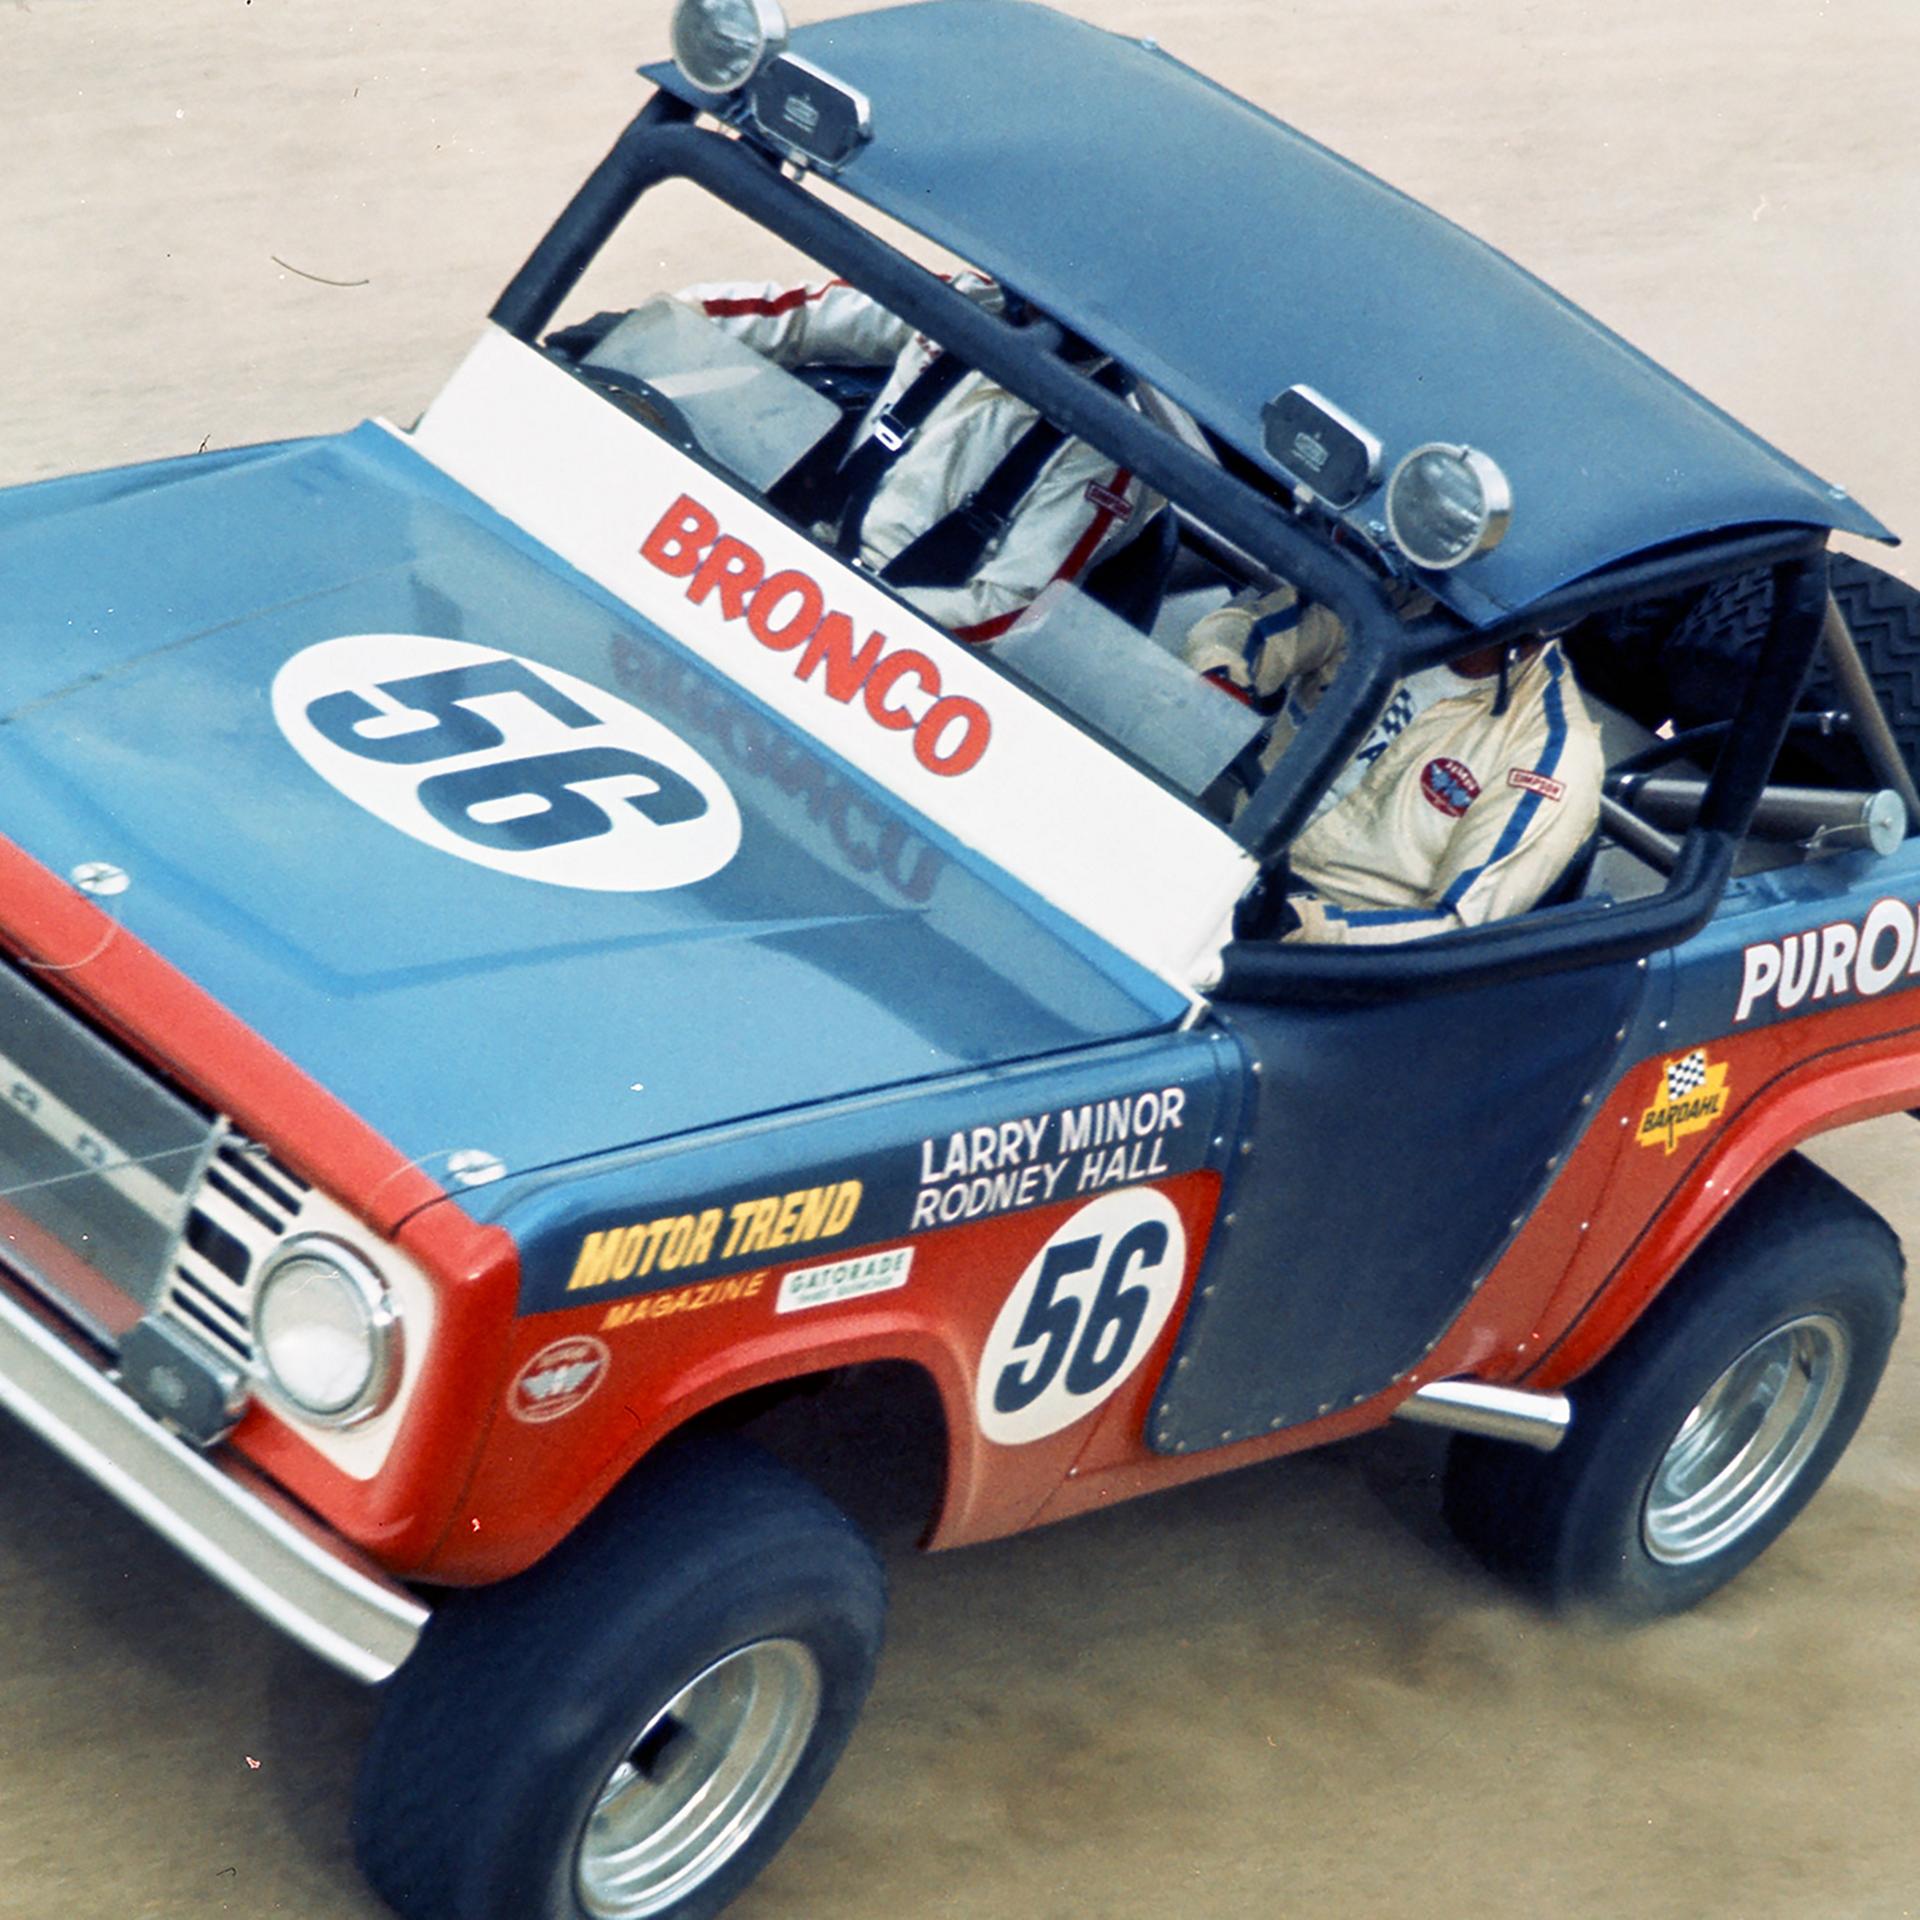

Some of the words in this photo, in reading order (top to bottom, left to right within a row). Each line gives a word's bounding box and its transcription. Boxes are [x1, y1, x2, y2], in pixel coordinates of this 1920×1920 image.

[639, 492, 992, 777] BRONCO
[305, 658, 708, 852] 56
[1733, 896, 1920, 1023] PURO
[919, 1113, 1050, 1185] LARRY
[1058, 1087, 1186, 1154] MINOR
[1641, 1093, 1720, 1134] BARDAHL
[566, 1207, 723, 1291] MOTOR
[720, 1180, 863, 1259] TREND
[909, 1157, 1070, 1231] RODNEY
[1077, 1136, 1168, 1192] HALL
[599, 1271, 769, 1332] MAGAZINE
[789, 1252, 906, 1294] GATORADE
[993, 1219, 1169, 1415] 56
